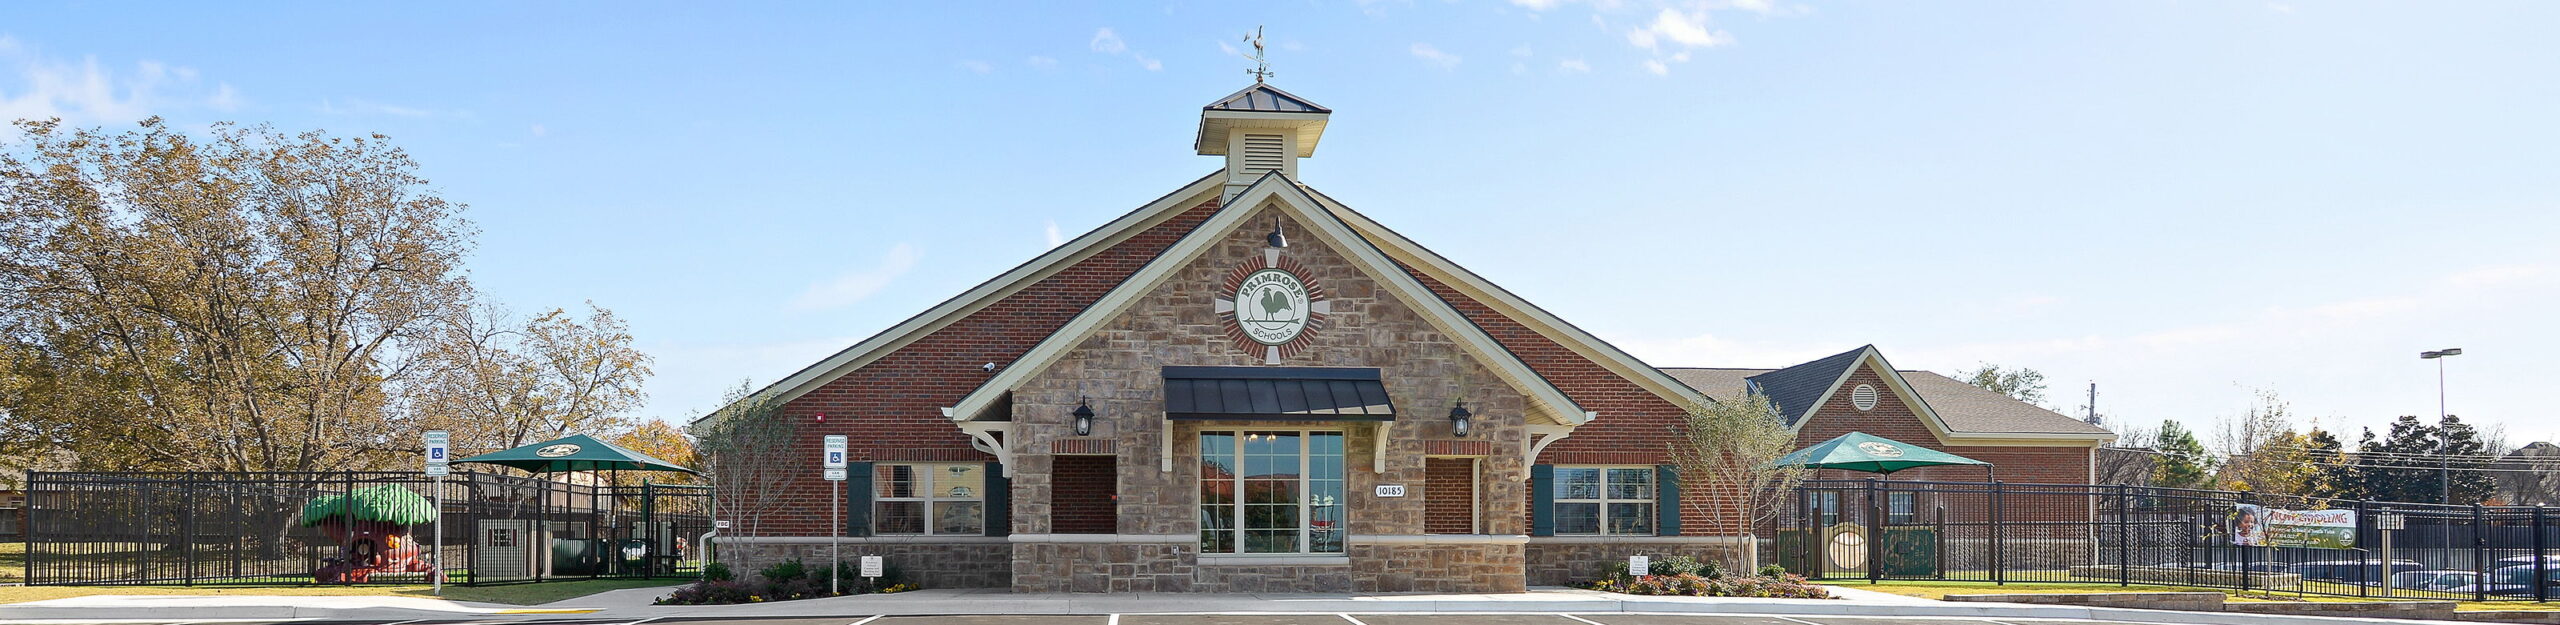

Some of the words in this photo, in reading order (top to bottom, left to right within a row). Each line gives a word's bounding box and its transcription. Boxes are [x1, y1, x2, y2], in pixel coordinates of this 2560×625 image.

[1241, 273, 1304, 298] PRIMROSE
[1252, 327, 1293, 341] SCHOOLS
[1379, 487, 1402, 495] 10185
